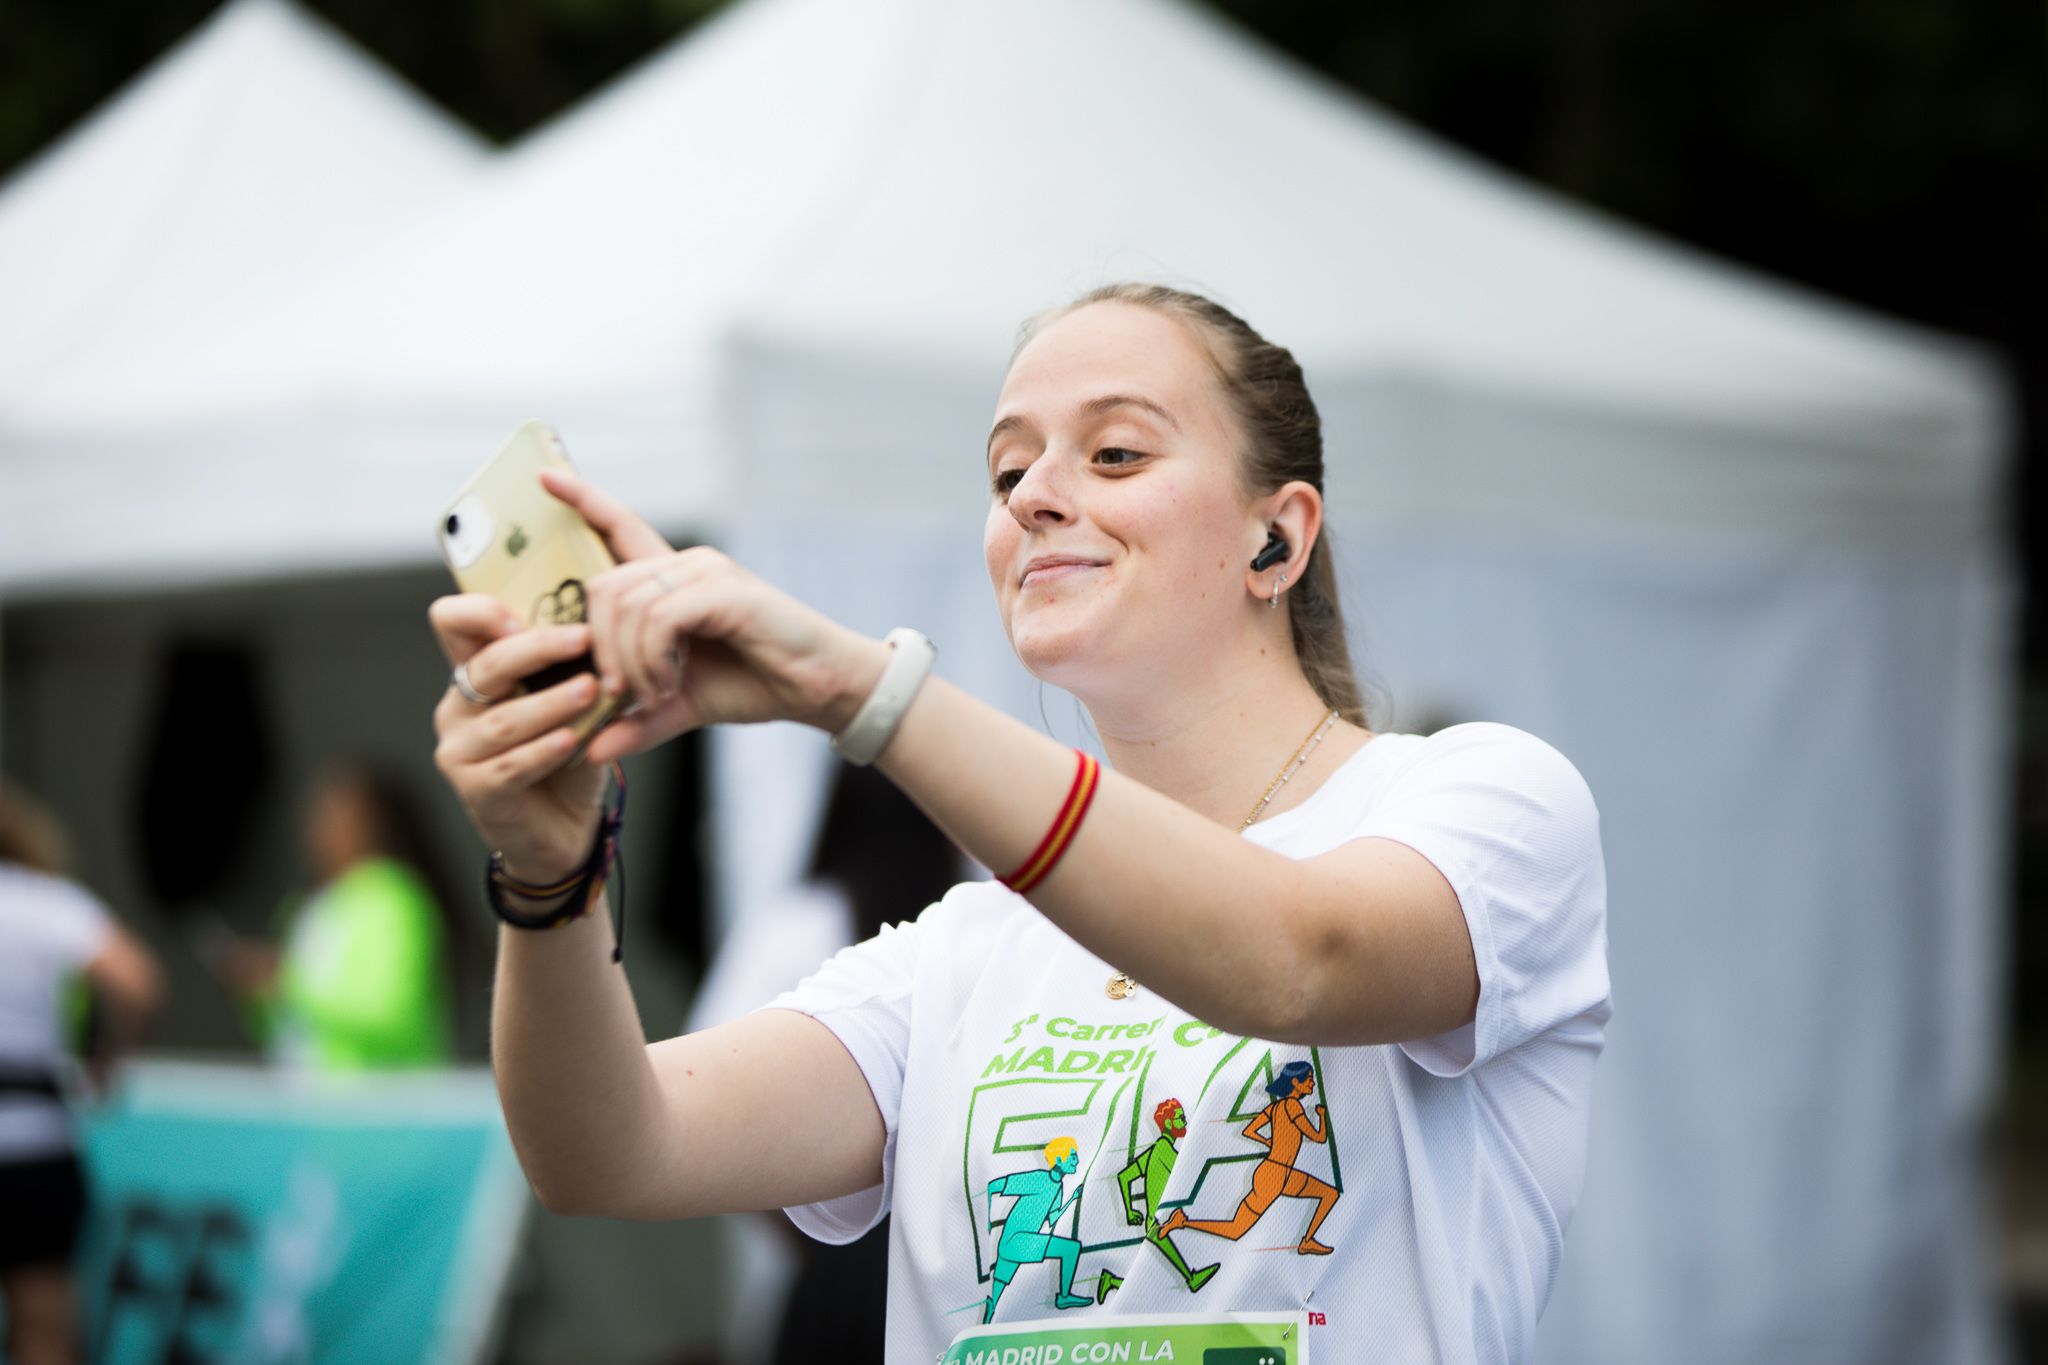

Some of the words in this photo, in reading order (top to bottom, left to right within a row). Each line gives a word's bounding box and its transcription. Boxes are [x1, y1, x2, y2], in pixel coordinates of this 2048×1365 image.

[1046, 1013, 1168, 1042] Carrer
[980, 1045, 1152, 1079] MADRI
[1308, 1311, 1326, 1326] na
[964, 1344, 1063, 1365] MADRID
[1070, 1341, 1131, 1364] CON
[1138, 1340, 1174, 1360] LA
